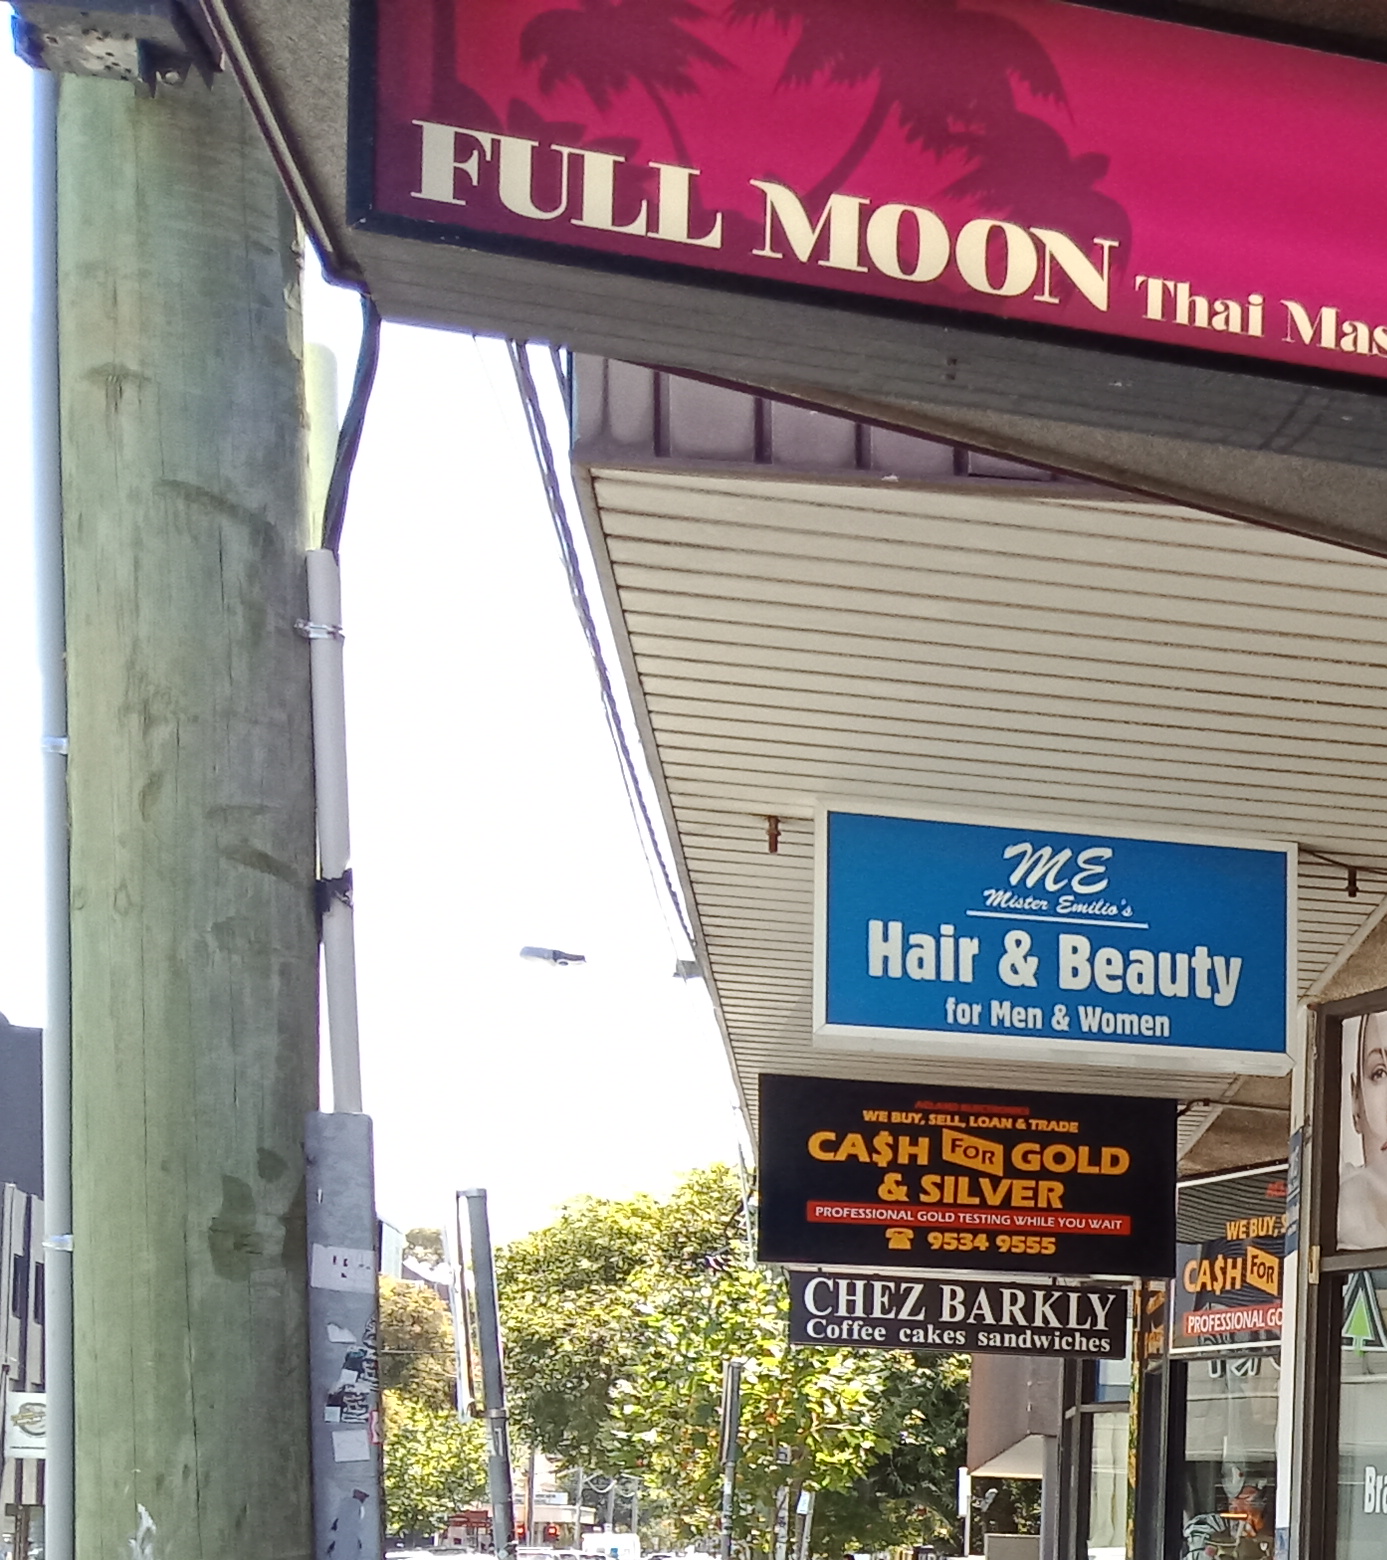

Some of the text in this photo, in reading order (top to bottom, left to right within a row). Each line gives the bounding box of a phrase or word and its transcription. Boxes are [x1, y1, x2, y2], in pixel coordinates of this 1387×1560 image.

[410, 119, 723, 249] FULL
[750, 179, 1120, 313] MOON
[1135, 273, 1264, 342] Thai
[1003, 842, 1113, 894] ME
[983, 889, 1133, 917] Mister Emilio's
[867, 919, 1243, 1007] Hair & Beauty
[945, 996, 1171, 1037] for Men & Women
[862, 1109, 1079, 1133] WE BUY, SELL, LOAN & TRADE
[807, 1130, 1131, 1175] CA$H FOR GOLD
[877, 1172, 1065, 1208] & SILVER
[815, 1206, 1122, 1230] PROFESSIONAL GOLD TESTING WHILE YOU WAIT
[1226, 1216, 1278, 1241] WE BUY,
[926, 1230, 1056, 1255] 9534 9555
[1183, 1253, 1275, 1296] CA$H FOR
[803, 1276, 1116, 1331] CHEZ BARKLY
[1187, 1307, 1284, 1334] PROFESSIONAL GO
[805, 1318, 1111, 1352] Coffee cakes sandwiches
